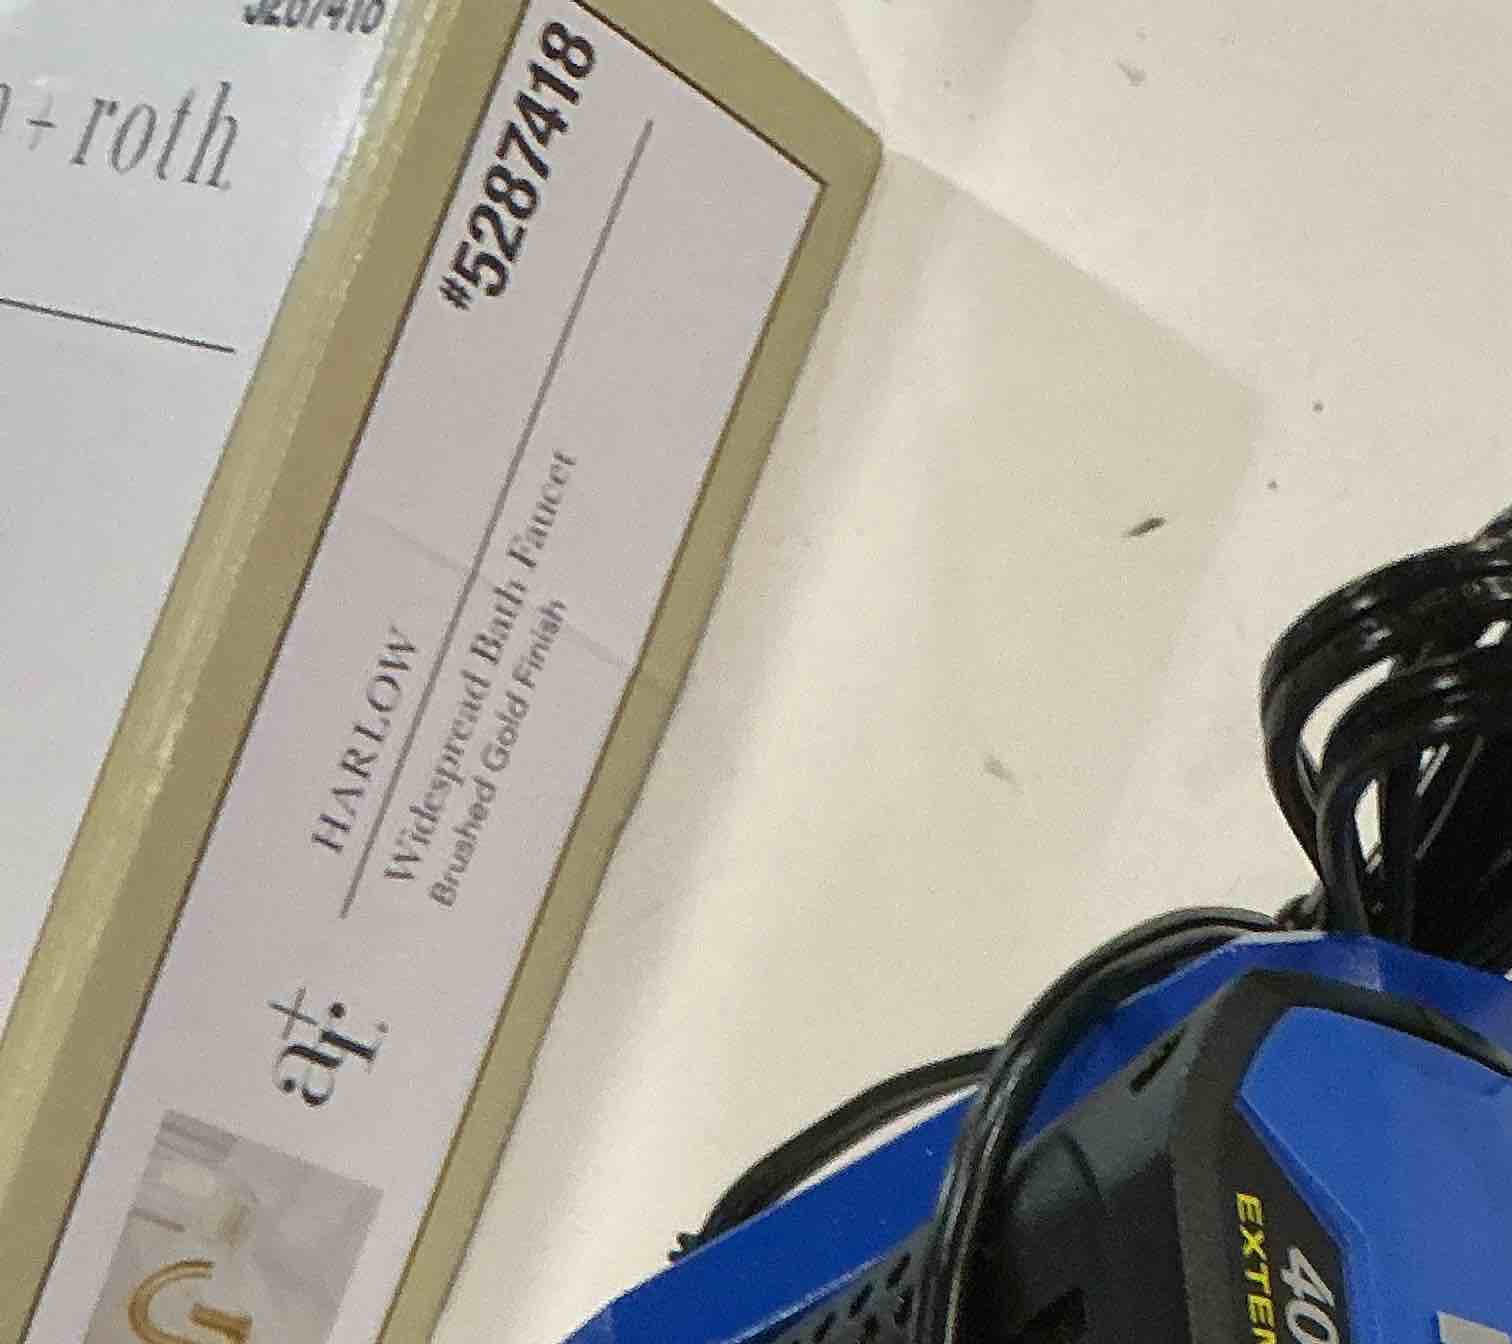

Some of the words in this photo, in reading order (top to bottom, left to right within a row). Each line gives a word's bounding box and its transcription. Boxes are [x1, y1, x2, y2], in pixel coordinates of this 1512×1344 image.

[70, 79, 242, 192] roth
[440, 21, 596, 312] #5287418
[311, 625, 418, 854] HARLOW
[383, 669, 492, 881] Widespread
[470, 580, 528, 666] Bath
[507, 448, 577, 568] Faucet
[429, 774, 498, 909] Brushed
[481, 691, 532, 773] Gold
[511, 600, 568, 690] Finish
